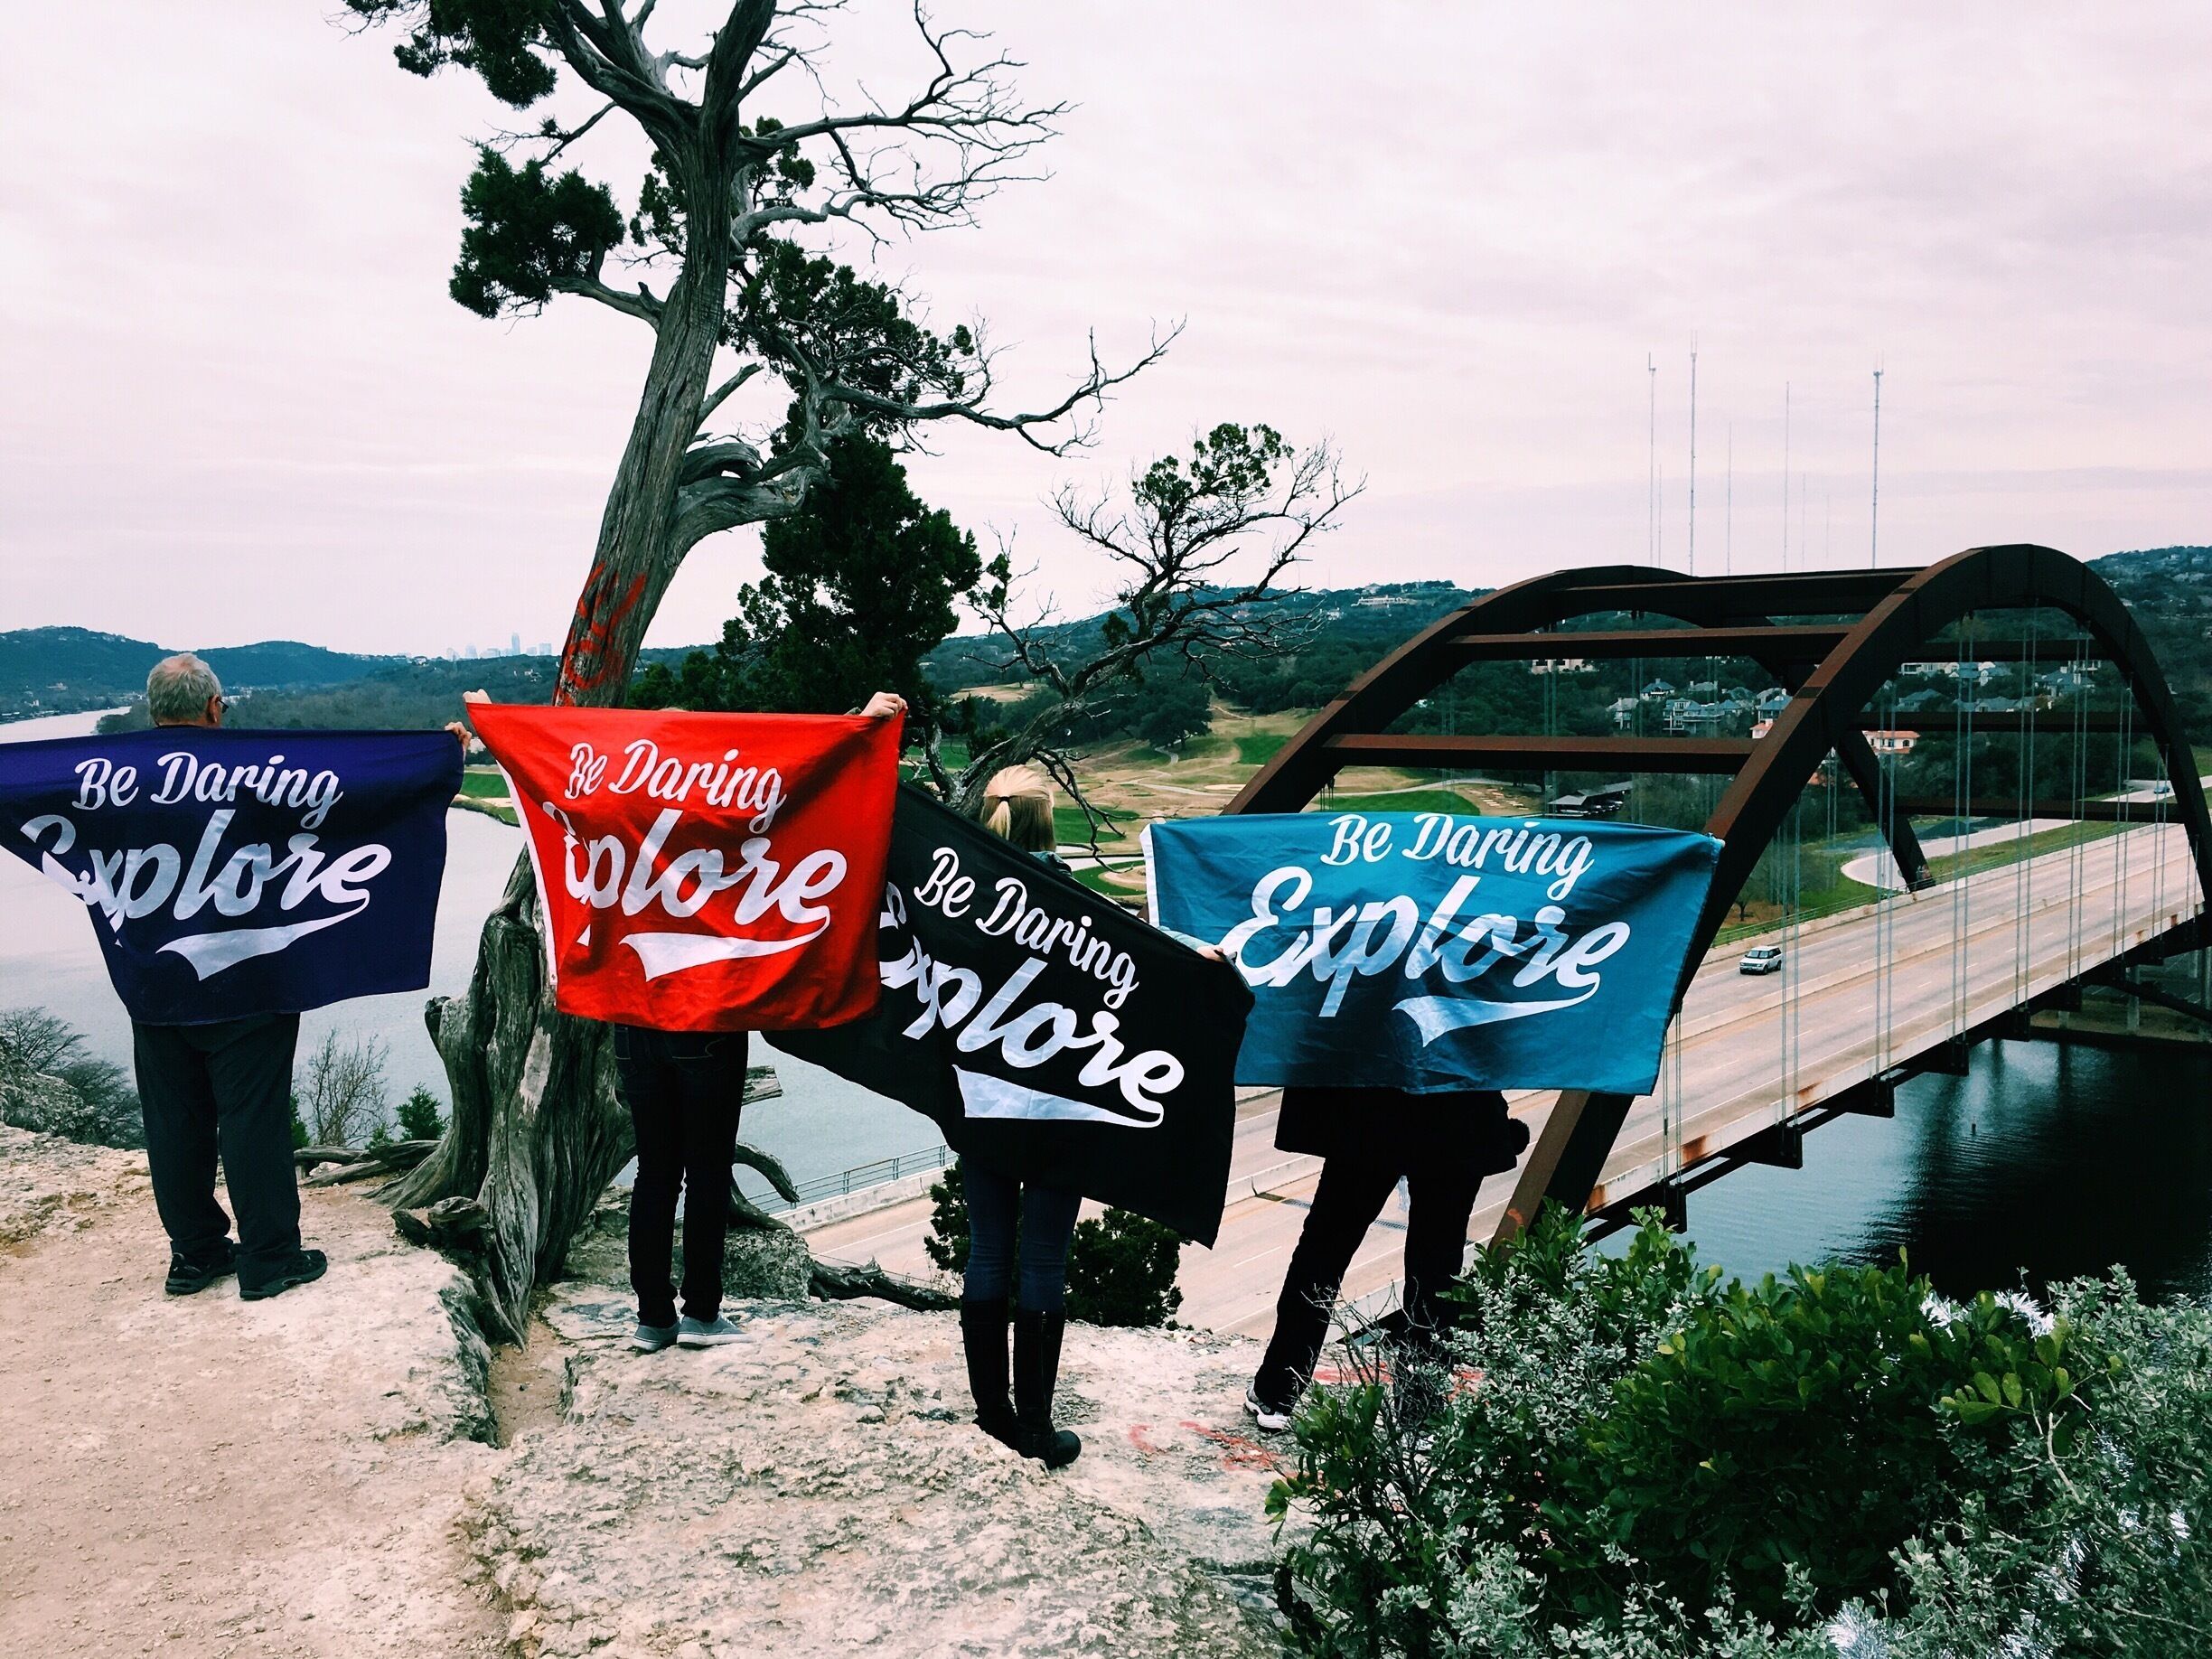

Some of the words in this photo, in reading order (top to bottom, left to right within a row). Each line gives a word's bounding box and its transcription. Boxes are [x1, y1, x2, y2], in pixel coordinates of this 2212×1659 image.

[71, 757, 139, 811] Be
[150, 752, 344, 830] Daring
[564, 742, 607, 799] Be
[608, 738, 788, 834] Daring
[542, 801, 848, 949] plore
[1319, 813, 1393, 867] Be
[1402, 812, 1595, 899] Daring
[914, 847, 976, 919] Be
[975, 876, 1140, 1010] Daring
[1218, 867, 1631, 1017] Explore
